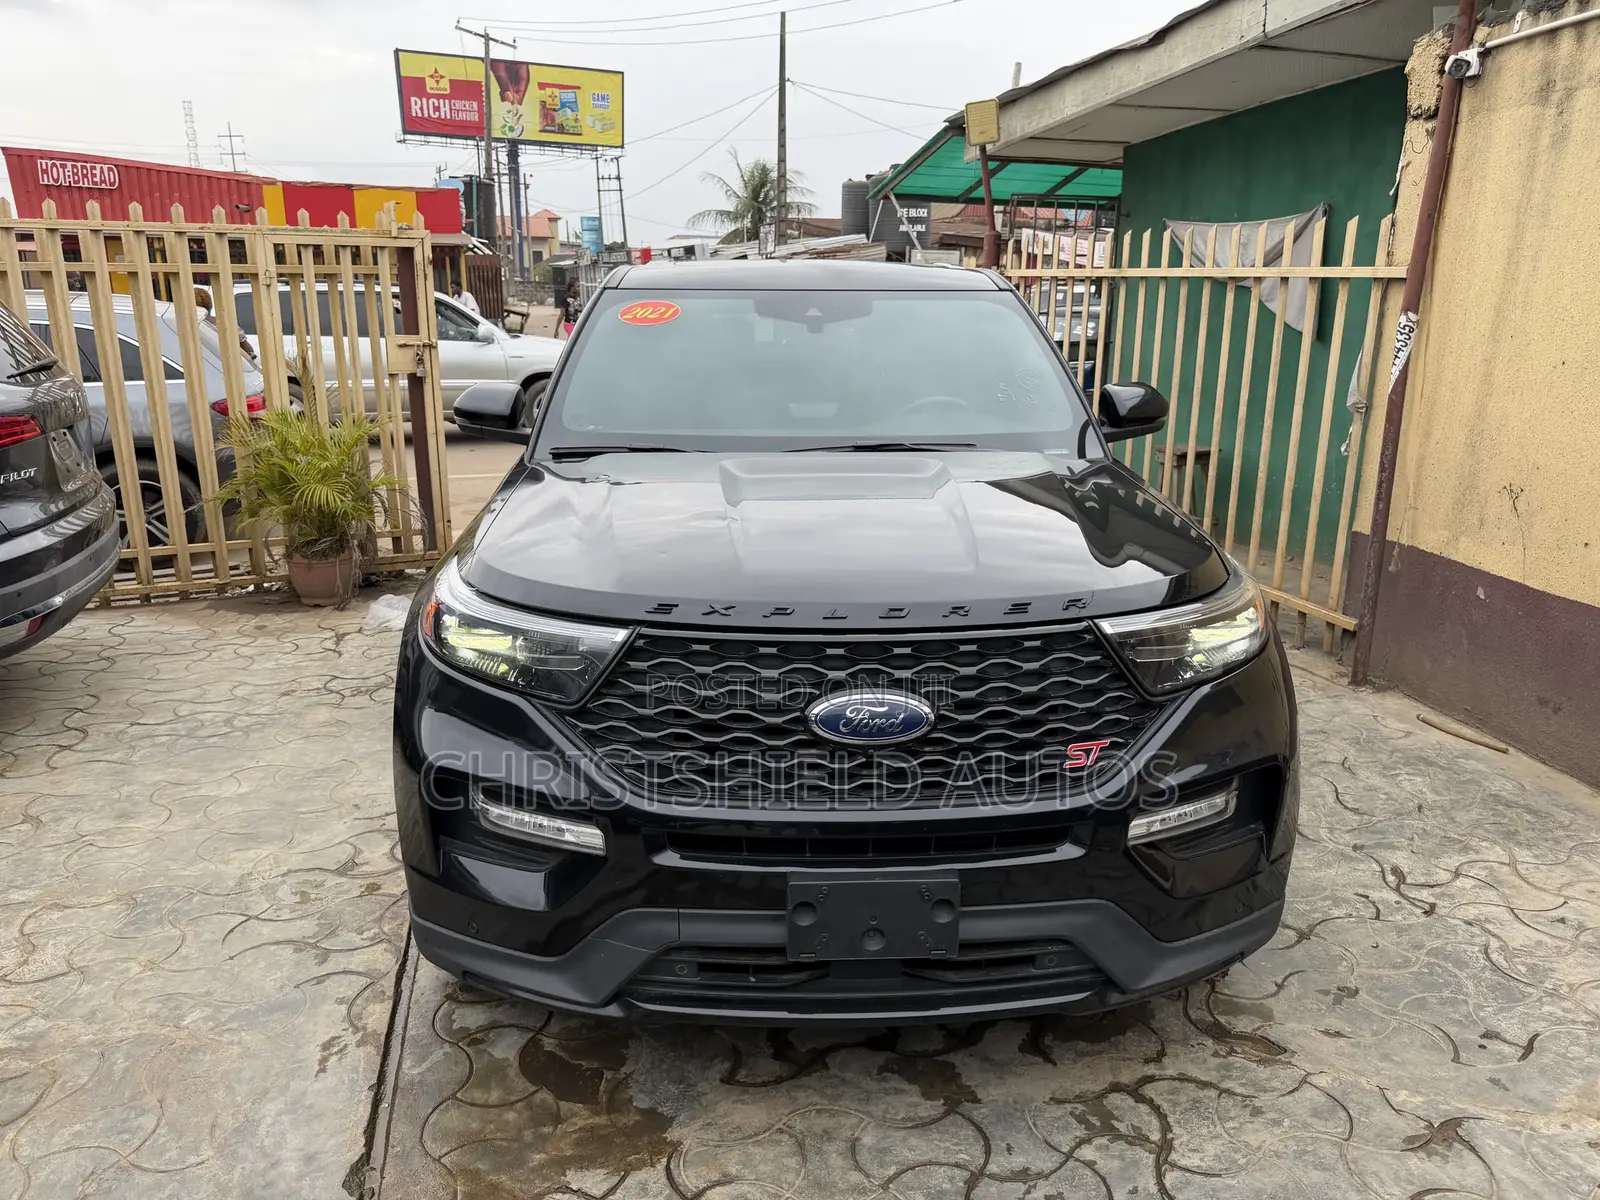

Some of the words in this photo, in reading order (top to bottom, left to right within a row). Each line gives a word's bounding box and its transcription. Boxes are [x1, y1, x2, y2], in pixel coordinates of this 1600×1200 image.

[410, 96, 451, 119] RICH
[451, 99, 478, 112] CHICKEN
[452, 110, 479, 122] FLAVOUR
[622, 306, 678, 319] 2021
[0, 467, 38, 485] PILOT
[644, 597, 1088, 619] EXPLORER
[839, 705, 904, 733] Ford
[1063, 741, 1110, 769] ST
